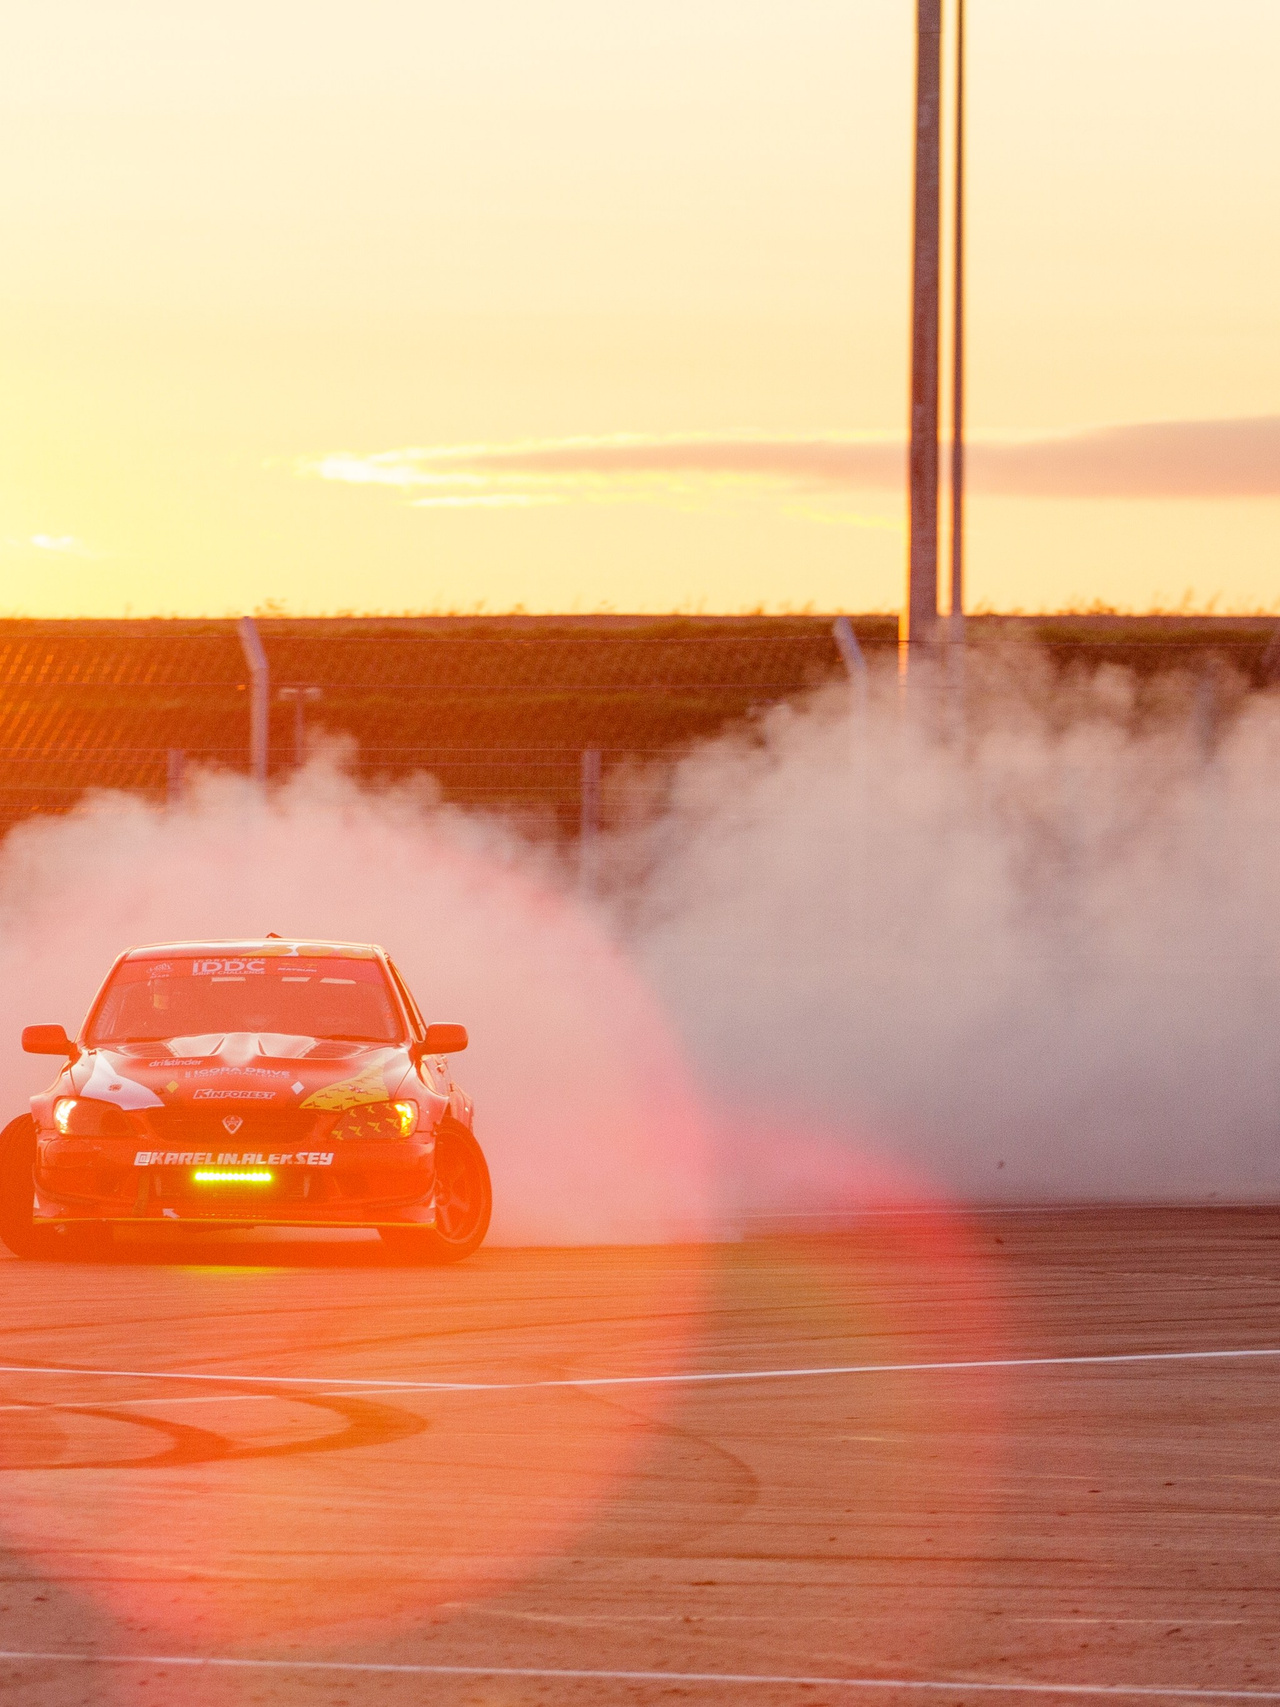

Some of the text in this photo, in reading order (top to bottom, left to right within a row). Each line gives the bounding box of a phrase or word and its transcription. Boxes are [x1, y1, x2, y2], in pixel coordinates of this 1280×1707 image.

[192, 960, 266, 974] IDDC
[194, 1067, 241, 1075] IGORA
[245, 1067, 290, 1076] DRIVE
[193, 1089, 276, 1099] KINFOREST
